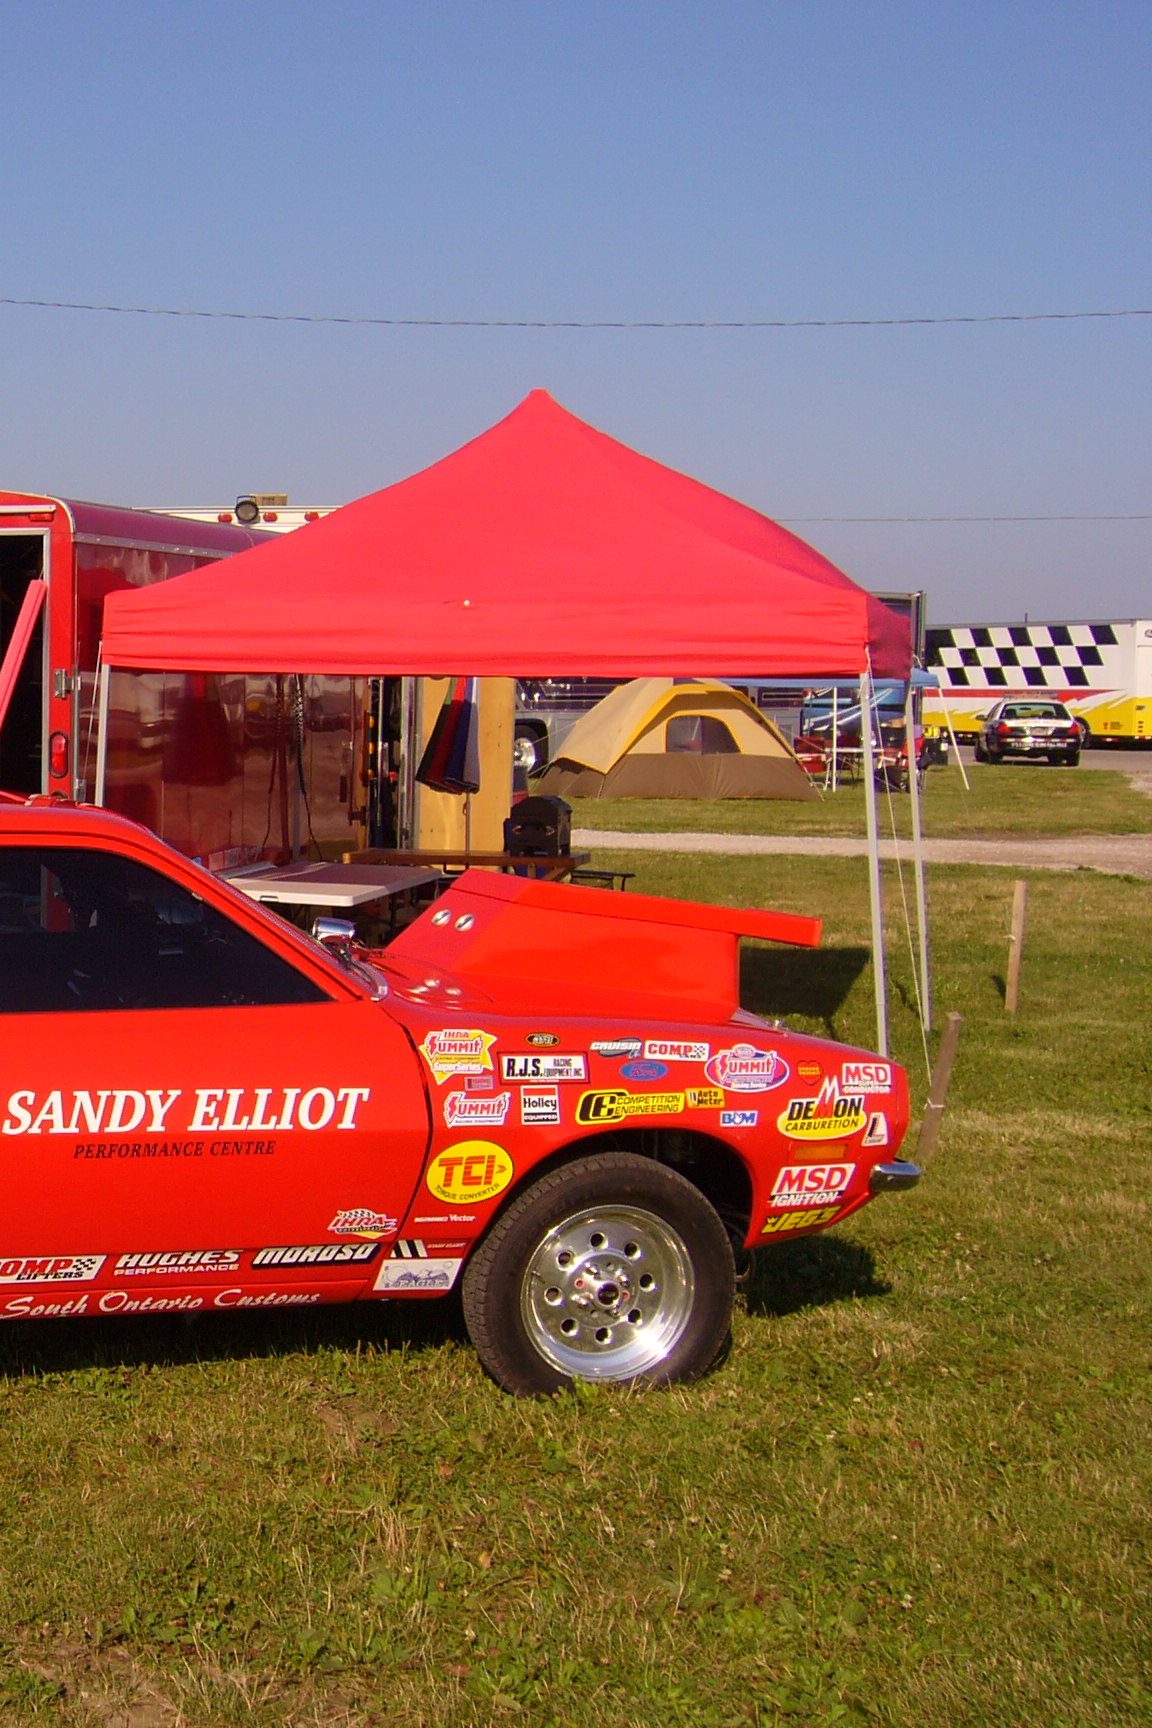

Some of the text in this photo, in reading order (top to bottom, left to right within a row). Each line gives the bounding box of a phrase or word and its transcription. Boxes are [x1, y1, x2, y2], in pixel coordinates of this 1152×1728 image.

[647, 1043, 693, 1055] COMP
[506, 1058, 543, 1077] R.J.S.
[553, 1058, 572, 1067] RACING
[844, 1065, 889, 1084] MSD
[616, 1094, 681, 1106] COMPETITION
[697, 1090, 719, 1098] Auto
[788, 1083, 863, 1120] DEMON
[2, 1087, 370, 1135] SANDY ELLIOT
[523, 1097, 558, 1111] Holley
[614, 1104, 679, 1115] ENGINEERING
[785, 1118, 859, 1131] CARBURETION
[73, 1140, 277, 1159] PERFORMANCE CENTRE
[438, 1154, 497, 1188] TCI
[775, 1166, 848, 1193] MSD
[459, 1182, 501, 1200] CONVERTER
[770, 1191, 839, 1207] IGNITION
[331, 1216, 385, 1228] IHRA
[114, 1249, 244, 1268] HUGHES
[252, 1242, 380, 1266] MOROSO
[16, 1270, 84, 1281] LIFTERS
[113, 1263, 240, 1276] PERFORMANCE
[98, 1291, 204, 1313] Ontario
[213, 1288, 321, 1307] Customs
